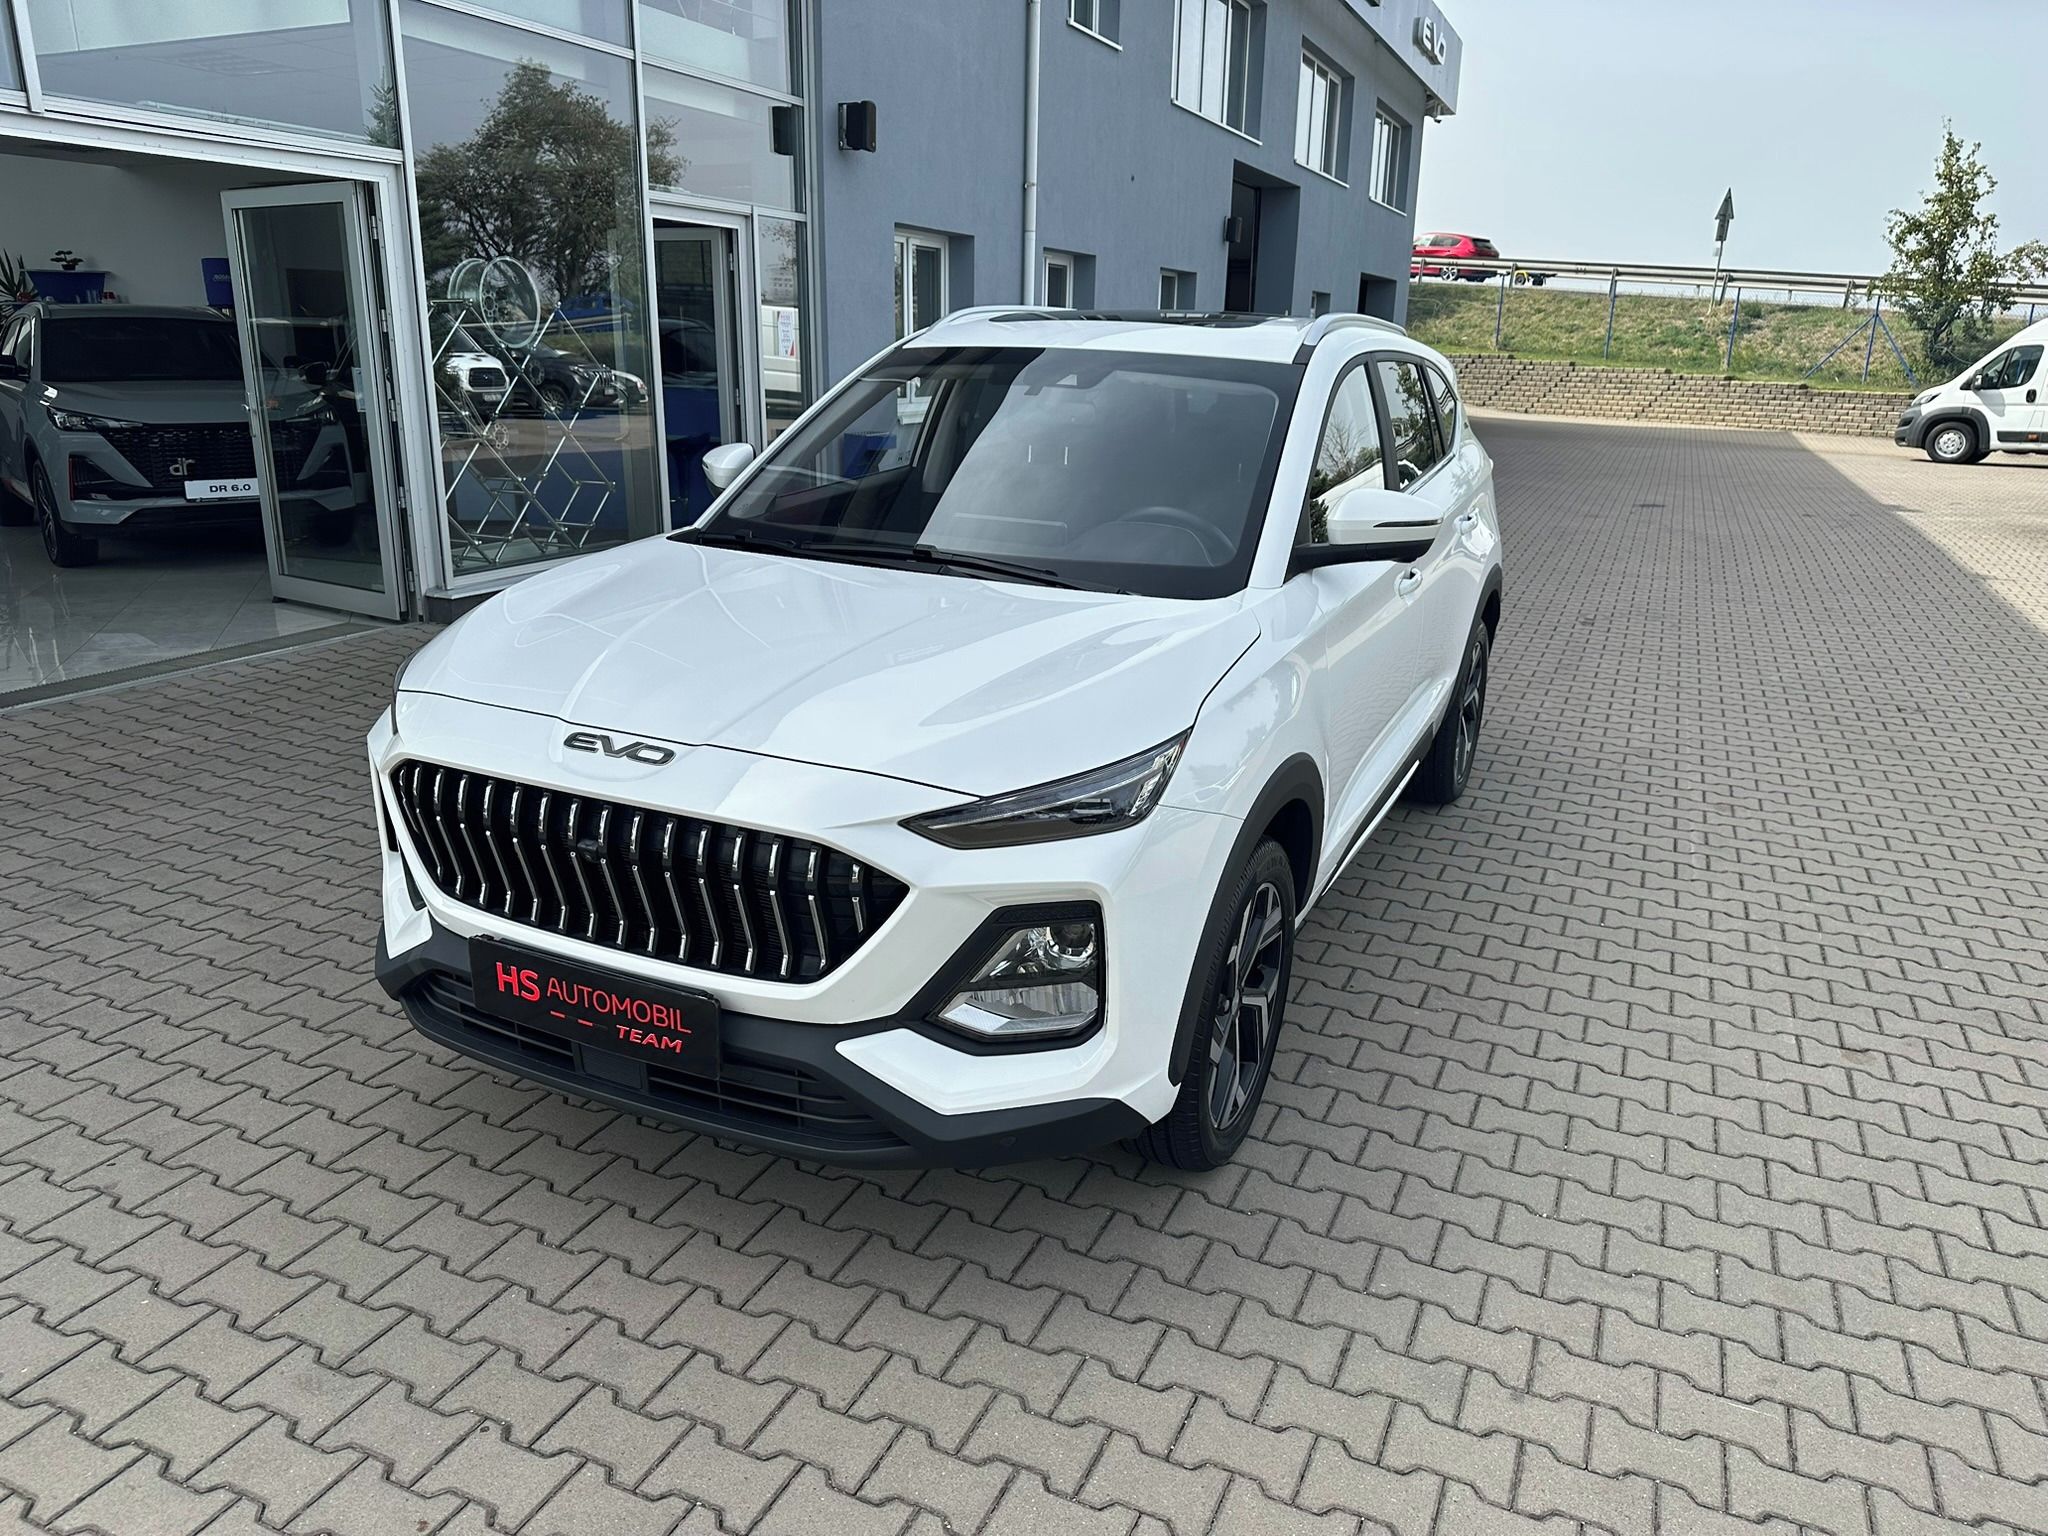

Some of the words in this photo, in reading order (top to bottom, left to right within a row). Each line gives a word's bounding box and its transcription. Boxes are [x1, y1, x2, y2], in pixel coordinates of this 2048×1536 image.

[1420, 16, 1447, 65] EVO
[209, 485, 228, 493] DR
[231, 483, 252, 492] 6.0
[563, 731, 677, 767] EVO
[496, 961, 541, 1002] HS
[546, 977, 693, 1034] AUTOMOBIL
[616, 1025, 683, 1053] TEAM
